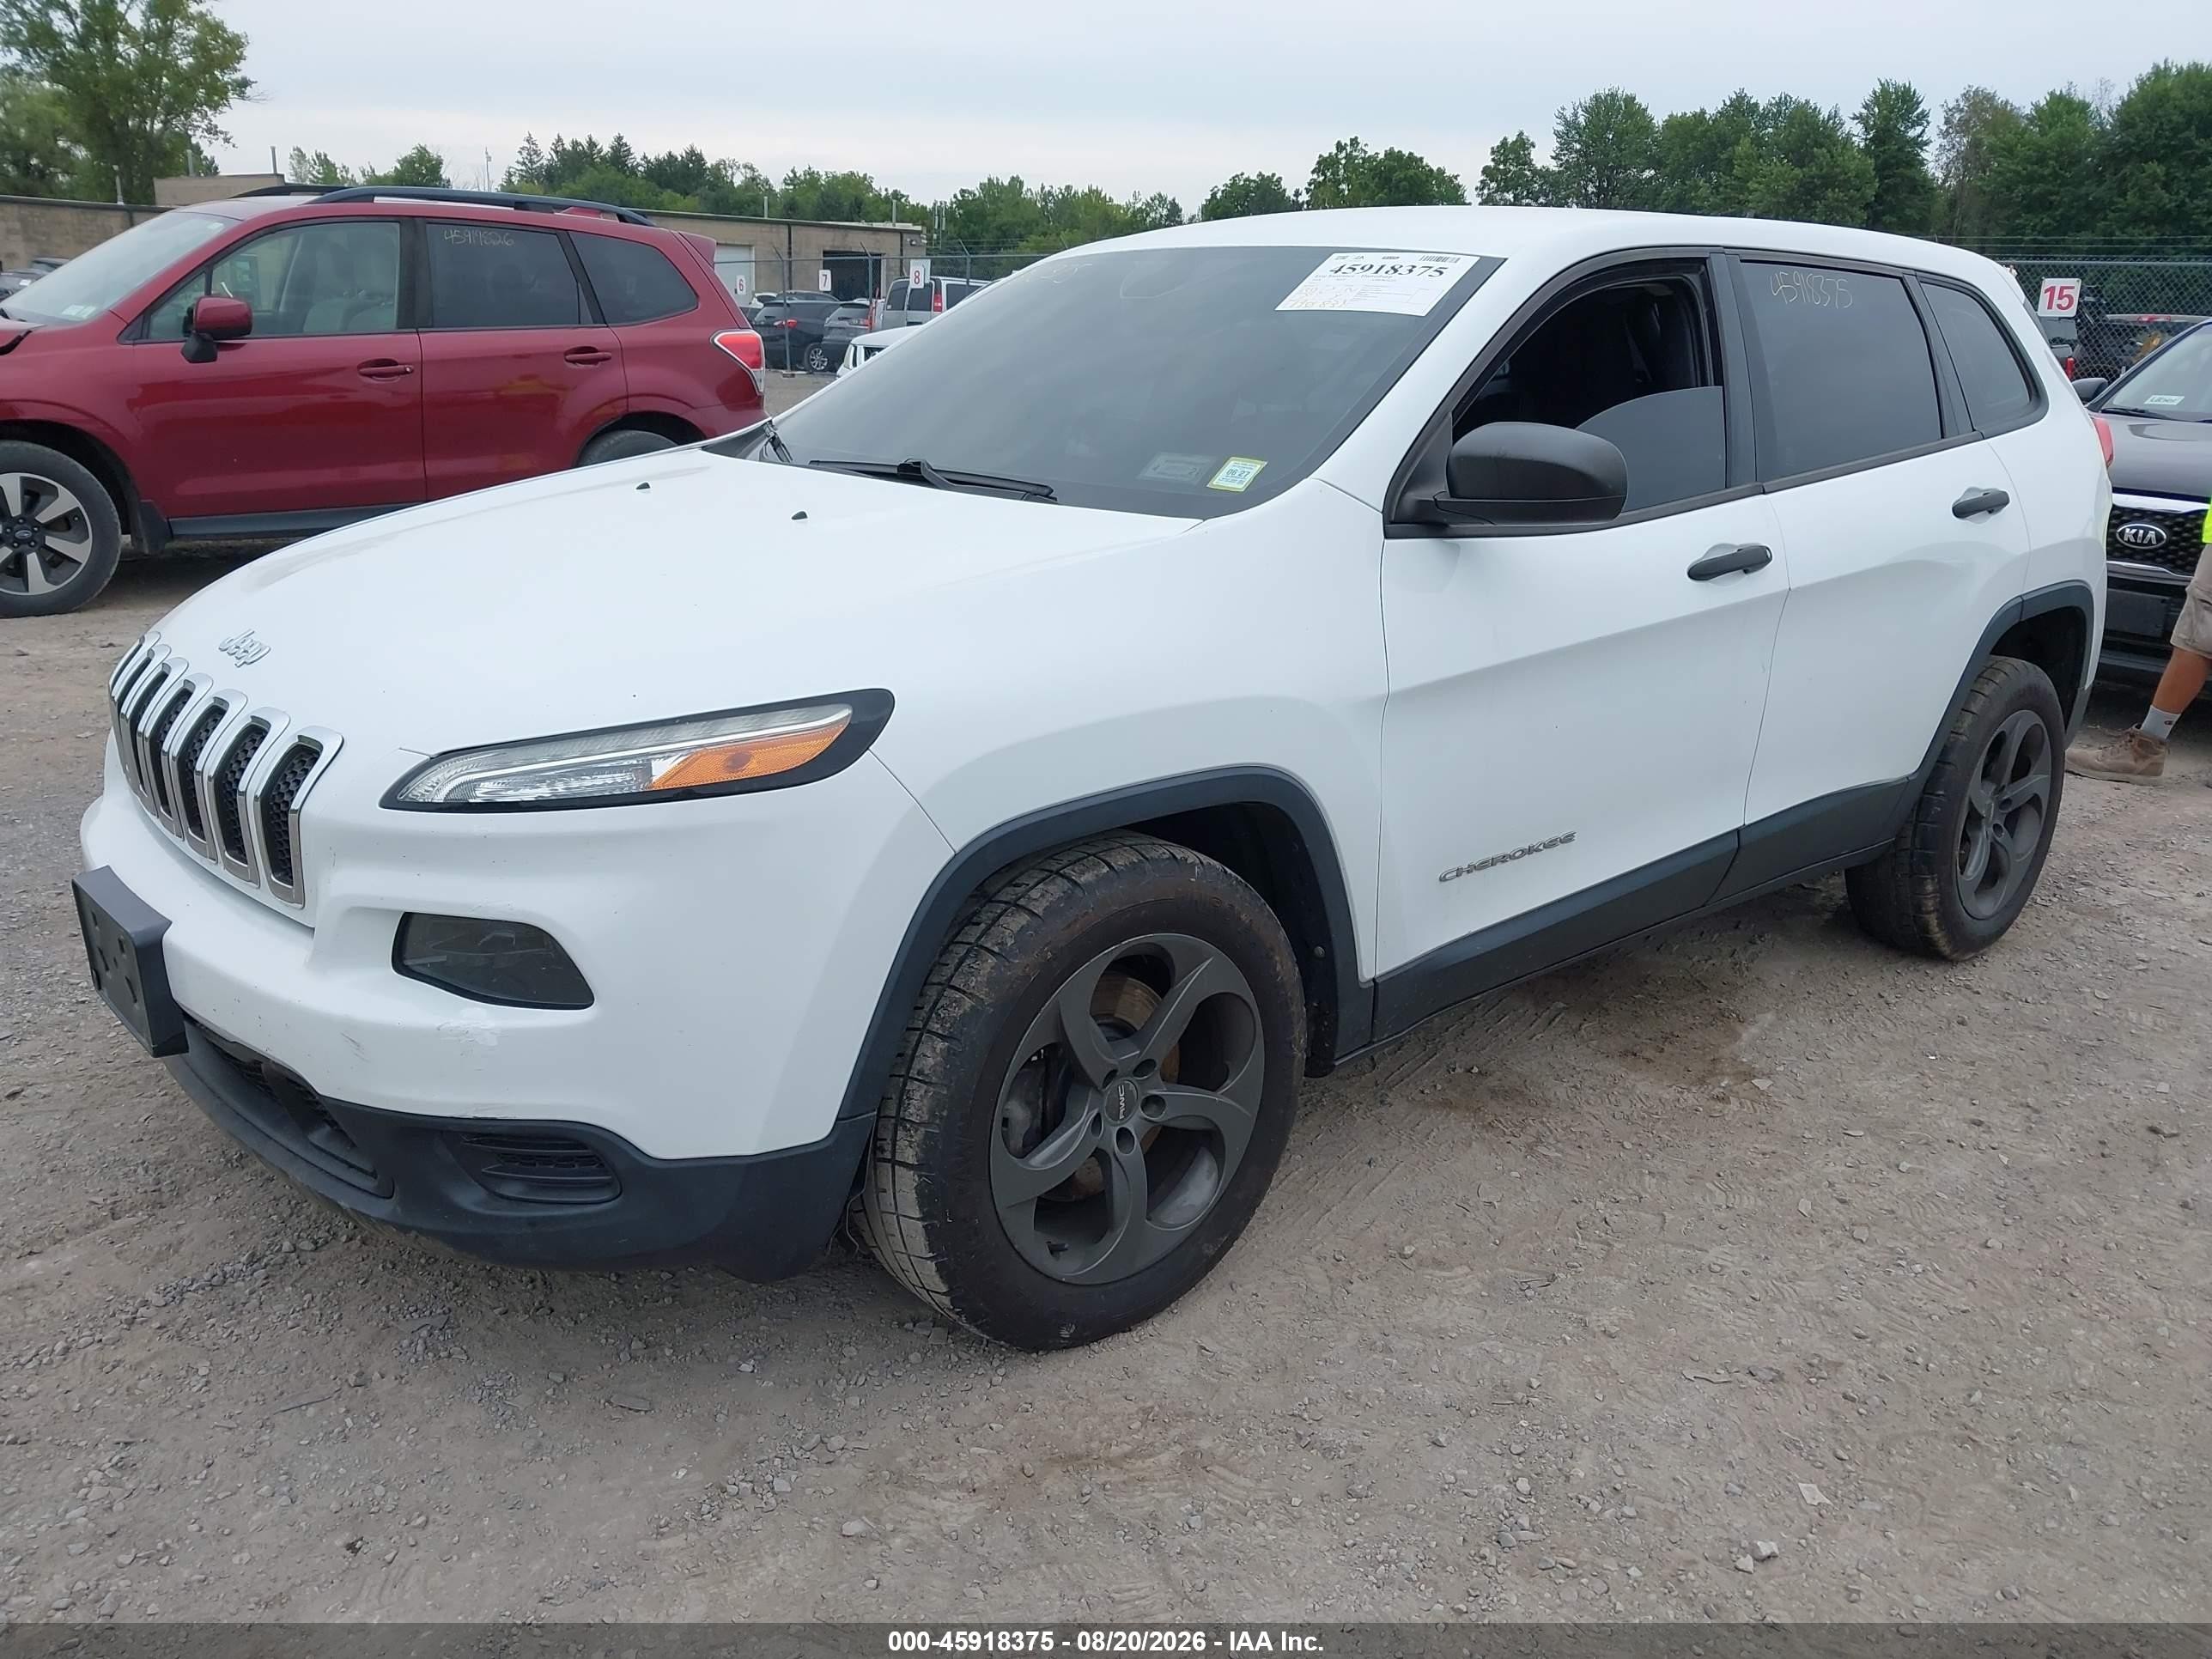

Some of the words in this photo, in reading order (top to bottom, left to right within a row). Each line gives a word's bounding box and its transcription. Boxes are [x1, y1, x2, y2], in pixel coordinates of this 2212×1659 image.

[913, 270, 921, 285] 8
[1329, 264, 1448, 278] 45918375
[738, 278, 744, 292] 6
[822, 274, 829, 288] 7
[1770, 271, 1853, 309] 45918375
[2044, 285, 2075, 311] 15
[2124, 528, 2157, 544] KIA
[218, 629, 271, 668] Jeep
[1439, 831, 1577, 882] CHEROKEE
